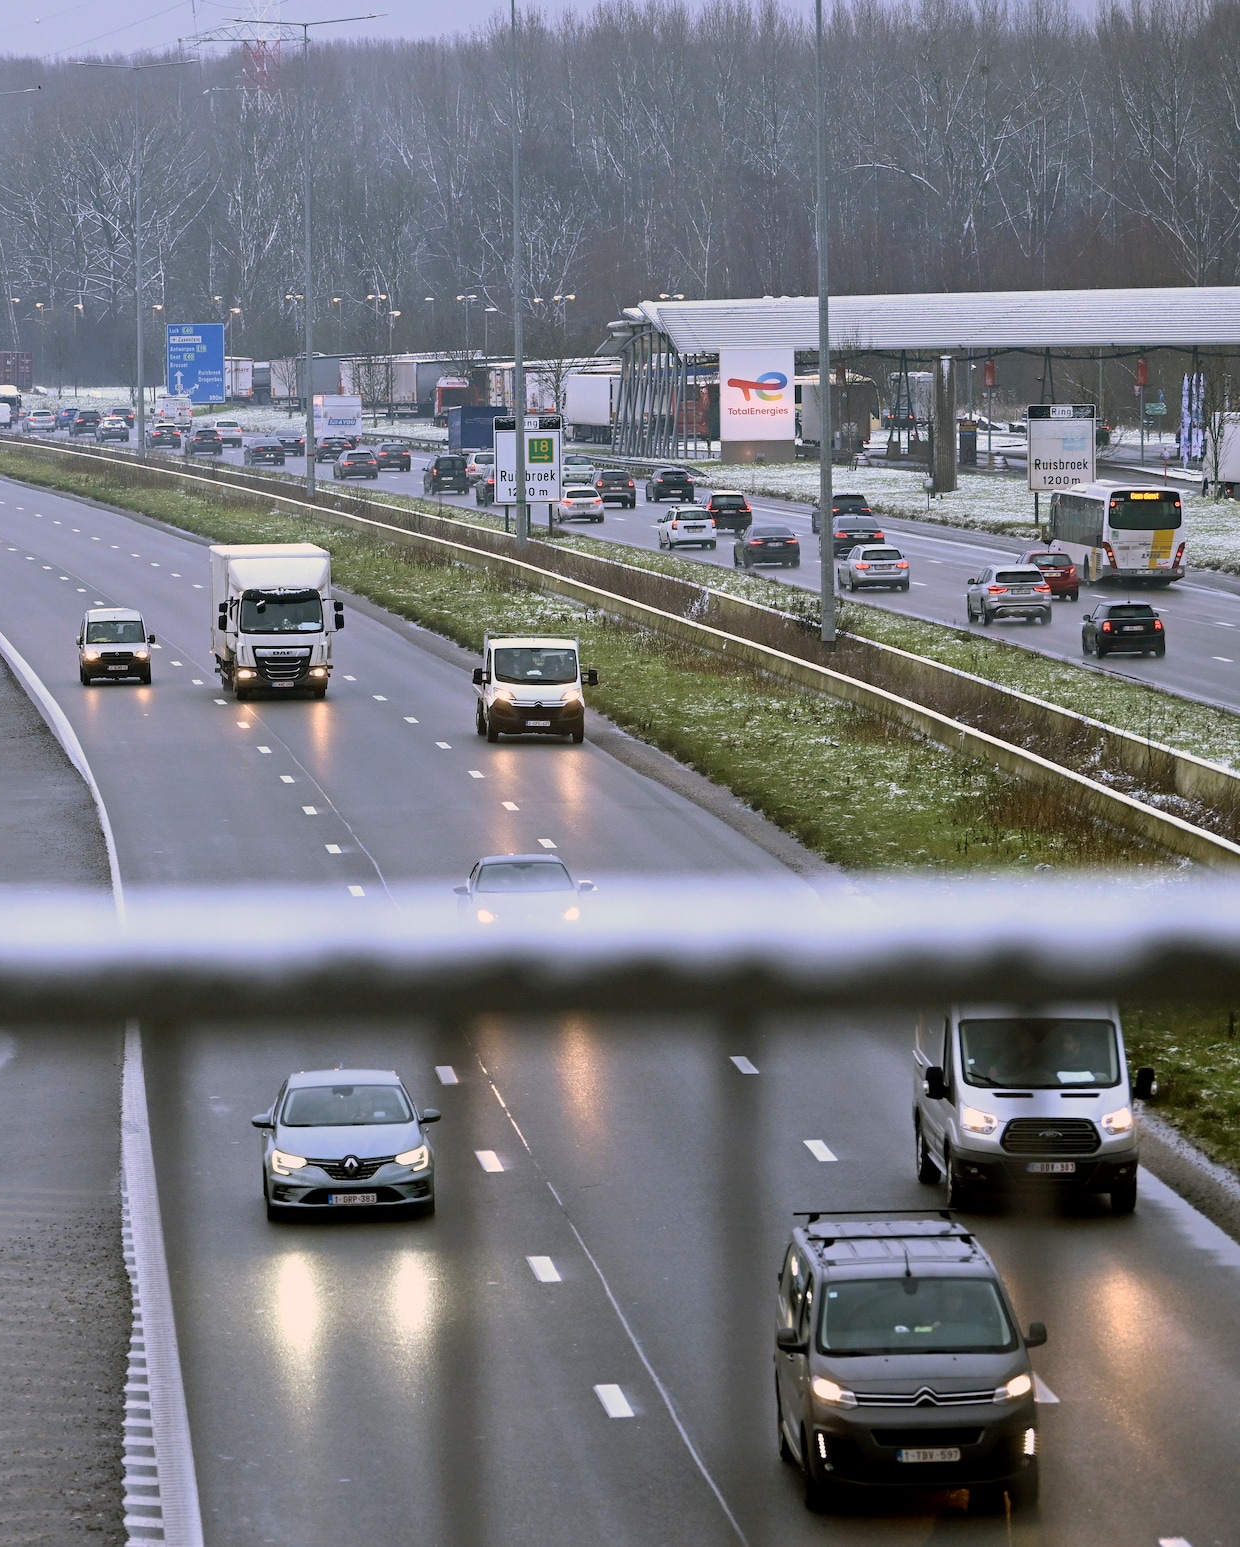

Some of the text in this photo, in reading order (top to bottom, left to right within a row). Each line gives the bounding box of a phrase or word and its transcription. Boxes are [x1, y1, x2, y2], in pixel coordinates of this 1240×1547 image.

[728, 407, 788, 416] TotalEnergies
[1051, 408, 1072, 417] Ring
[533, 440, 549, 453] 18
[1034, 459, 1088, 470] Ruisbroek
[500, 470, 556, 482] Rubroek
[508, 487, 535, 496] 120
[904, 1450, 958, 1461] 1-TBV-597
